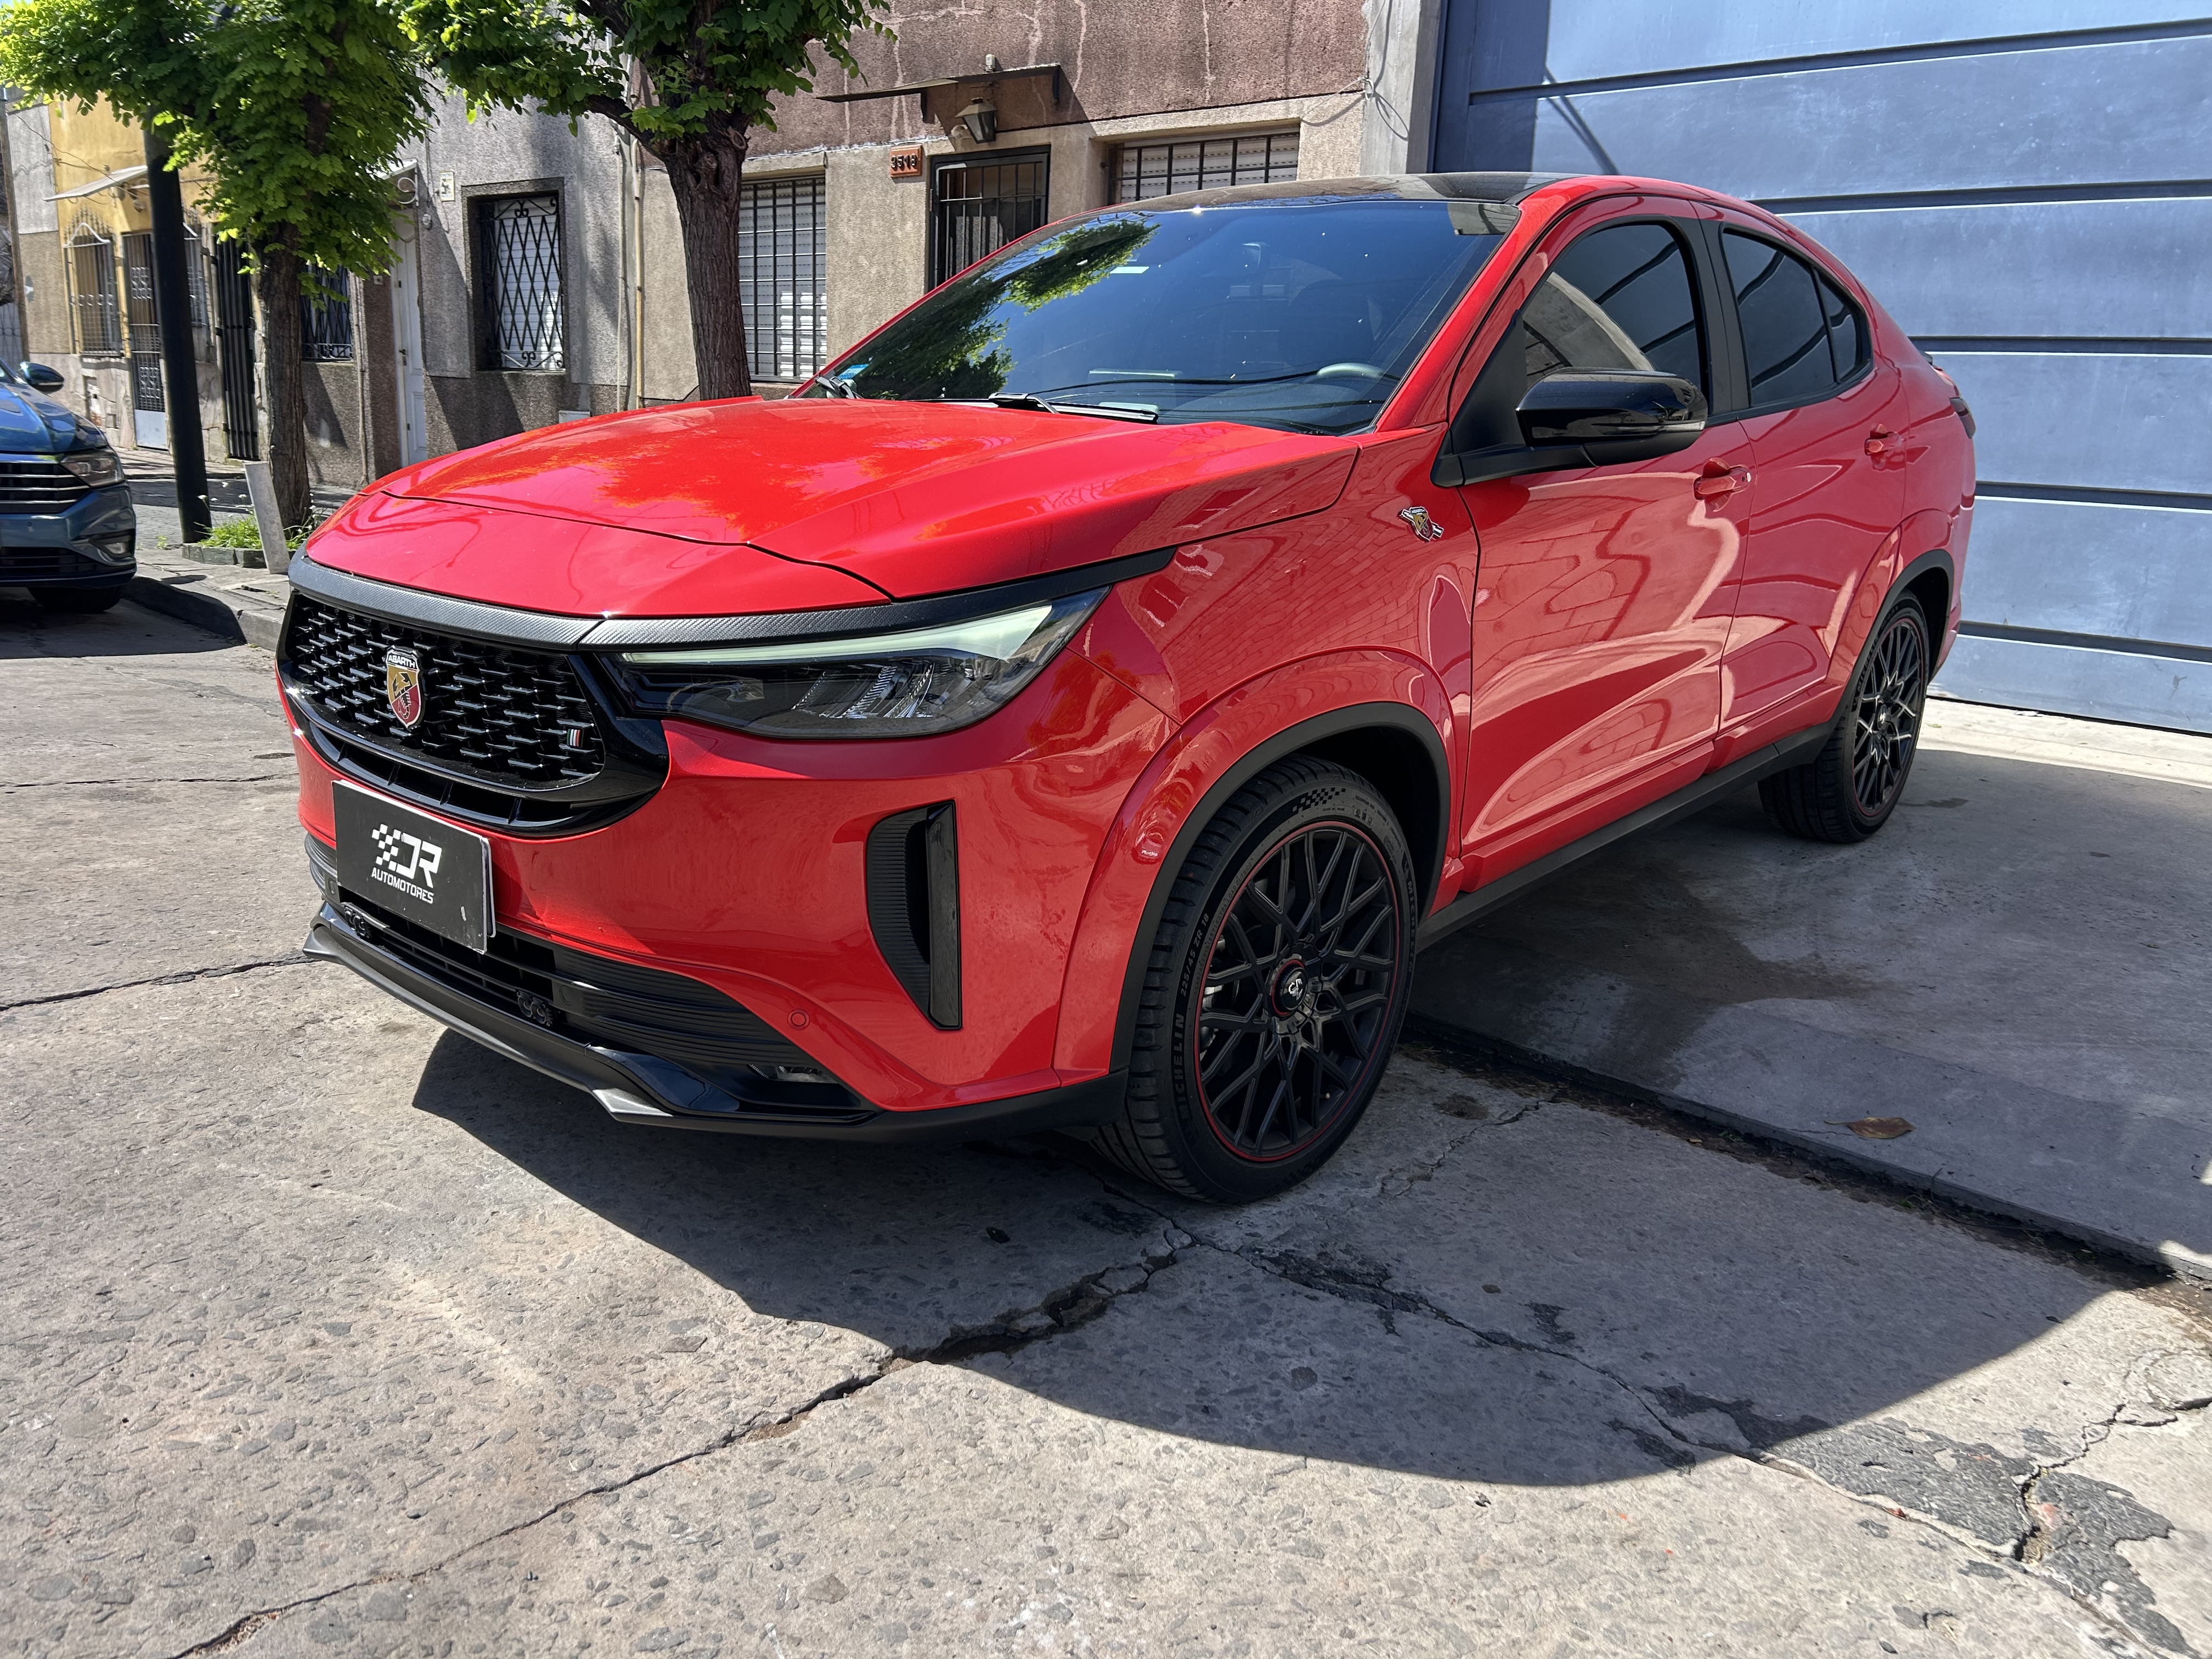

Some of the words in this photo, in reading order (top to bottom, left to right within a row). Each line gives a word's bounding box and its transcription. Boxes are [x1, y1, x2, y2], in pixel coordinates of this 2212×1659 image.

[388, 654, 415, 668] ABARTH
[371, 866, 435, 905] AUTOMOTORES
[1227, 885, 1237, 902] LOAD
[1201, 912, 1209, 927] 18
[1193, 929, 1203, 947] ZR
[1180, 949, 1196, 997] 225/45
[1173, 1013, 1191, 1120] MICHELIN
